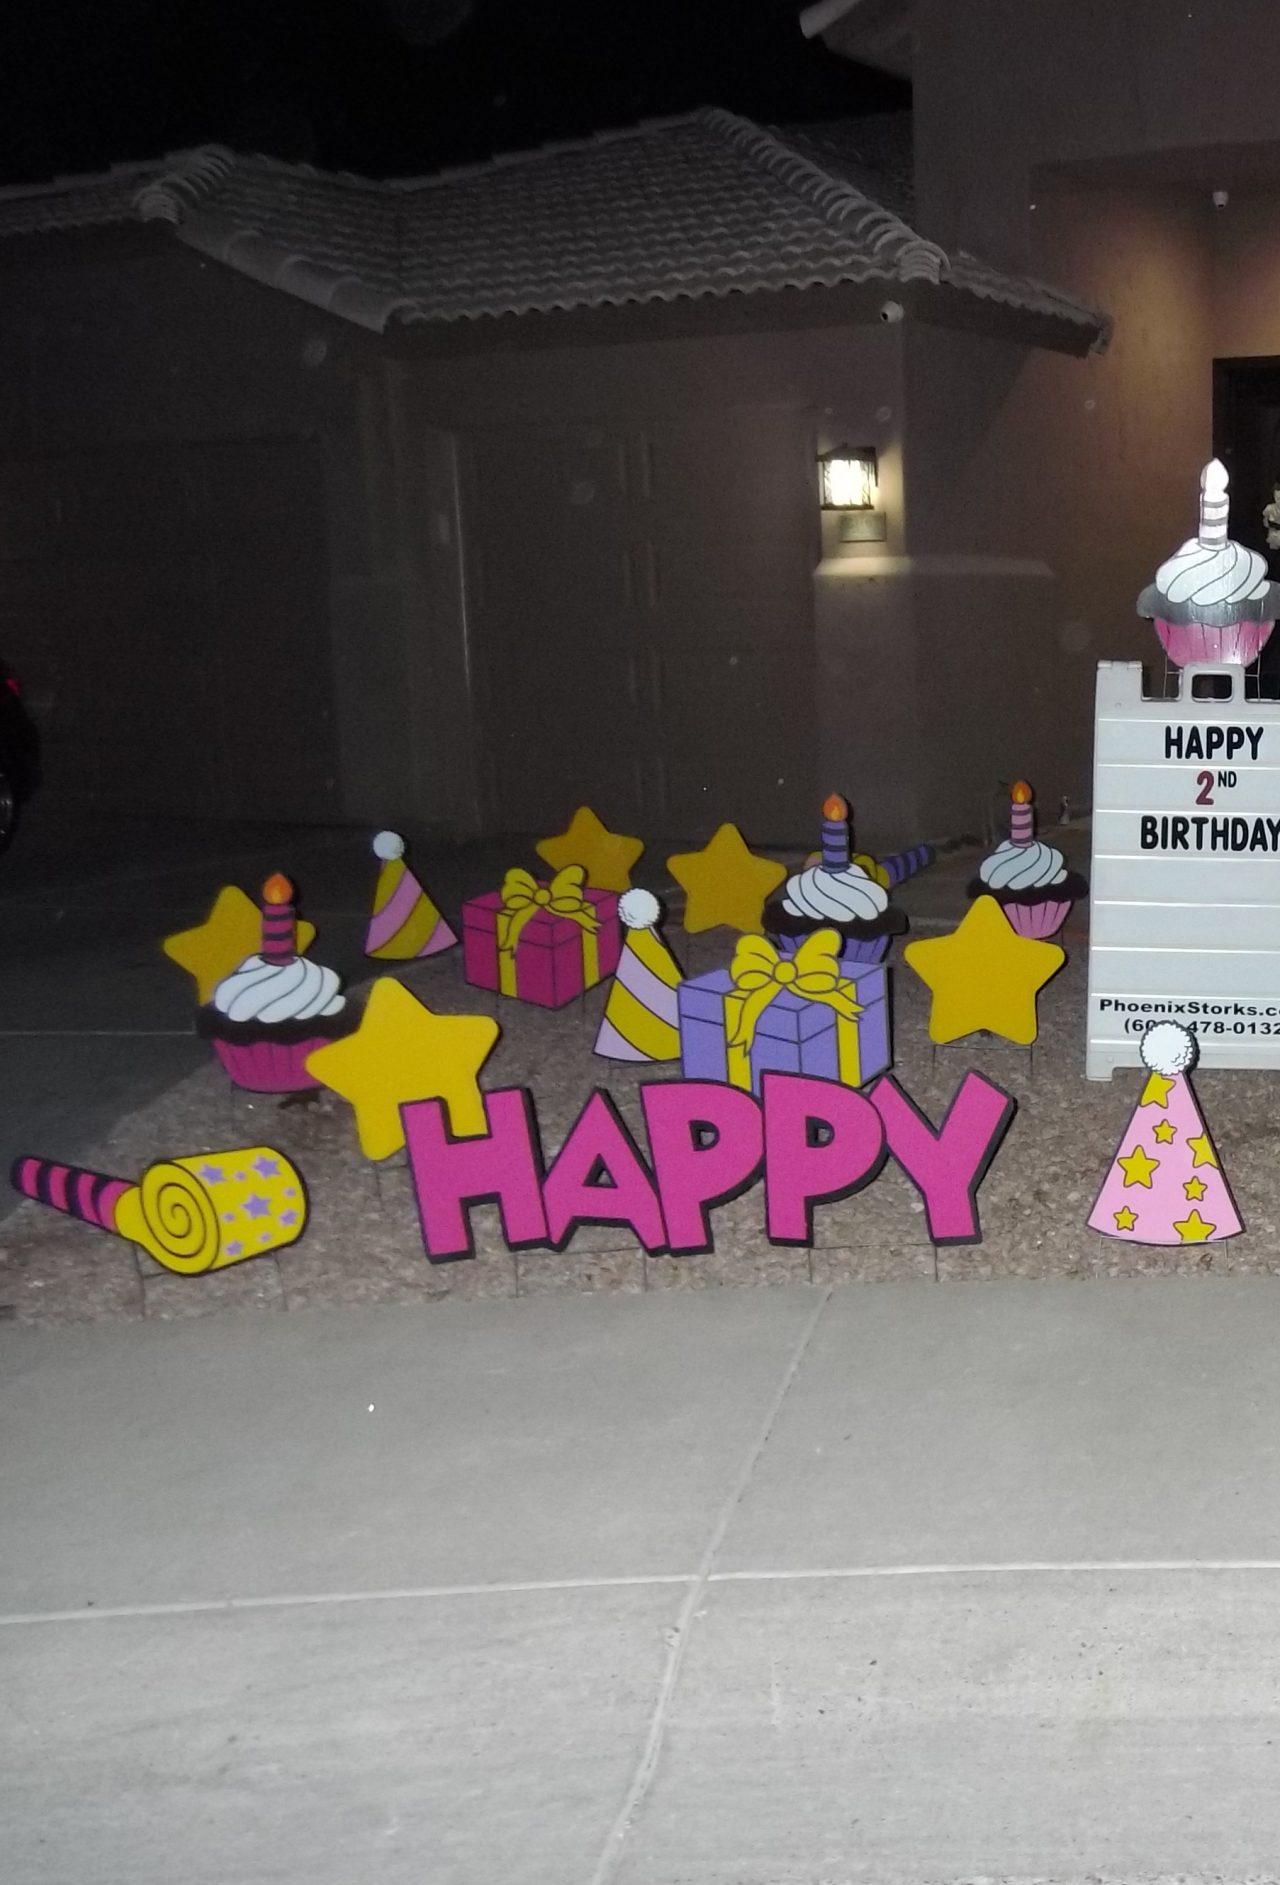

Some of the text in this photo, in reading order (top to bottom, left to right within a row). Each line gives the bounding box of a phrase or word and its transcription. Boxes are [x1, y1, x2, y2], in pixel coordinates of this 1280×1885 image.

[1164, 725, 1264, 761] HAPPY
[1195, 770, 1237, 805] 2ND
[400, 1069, 1017, 1264] HAPPY
